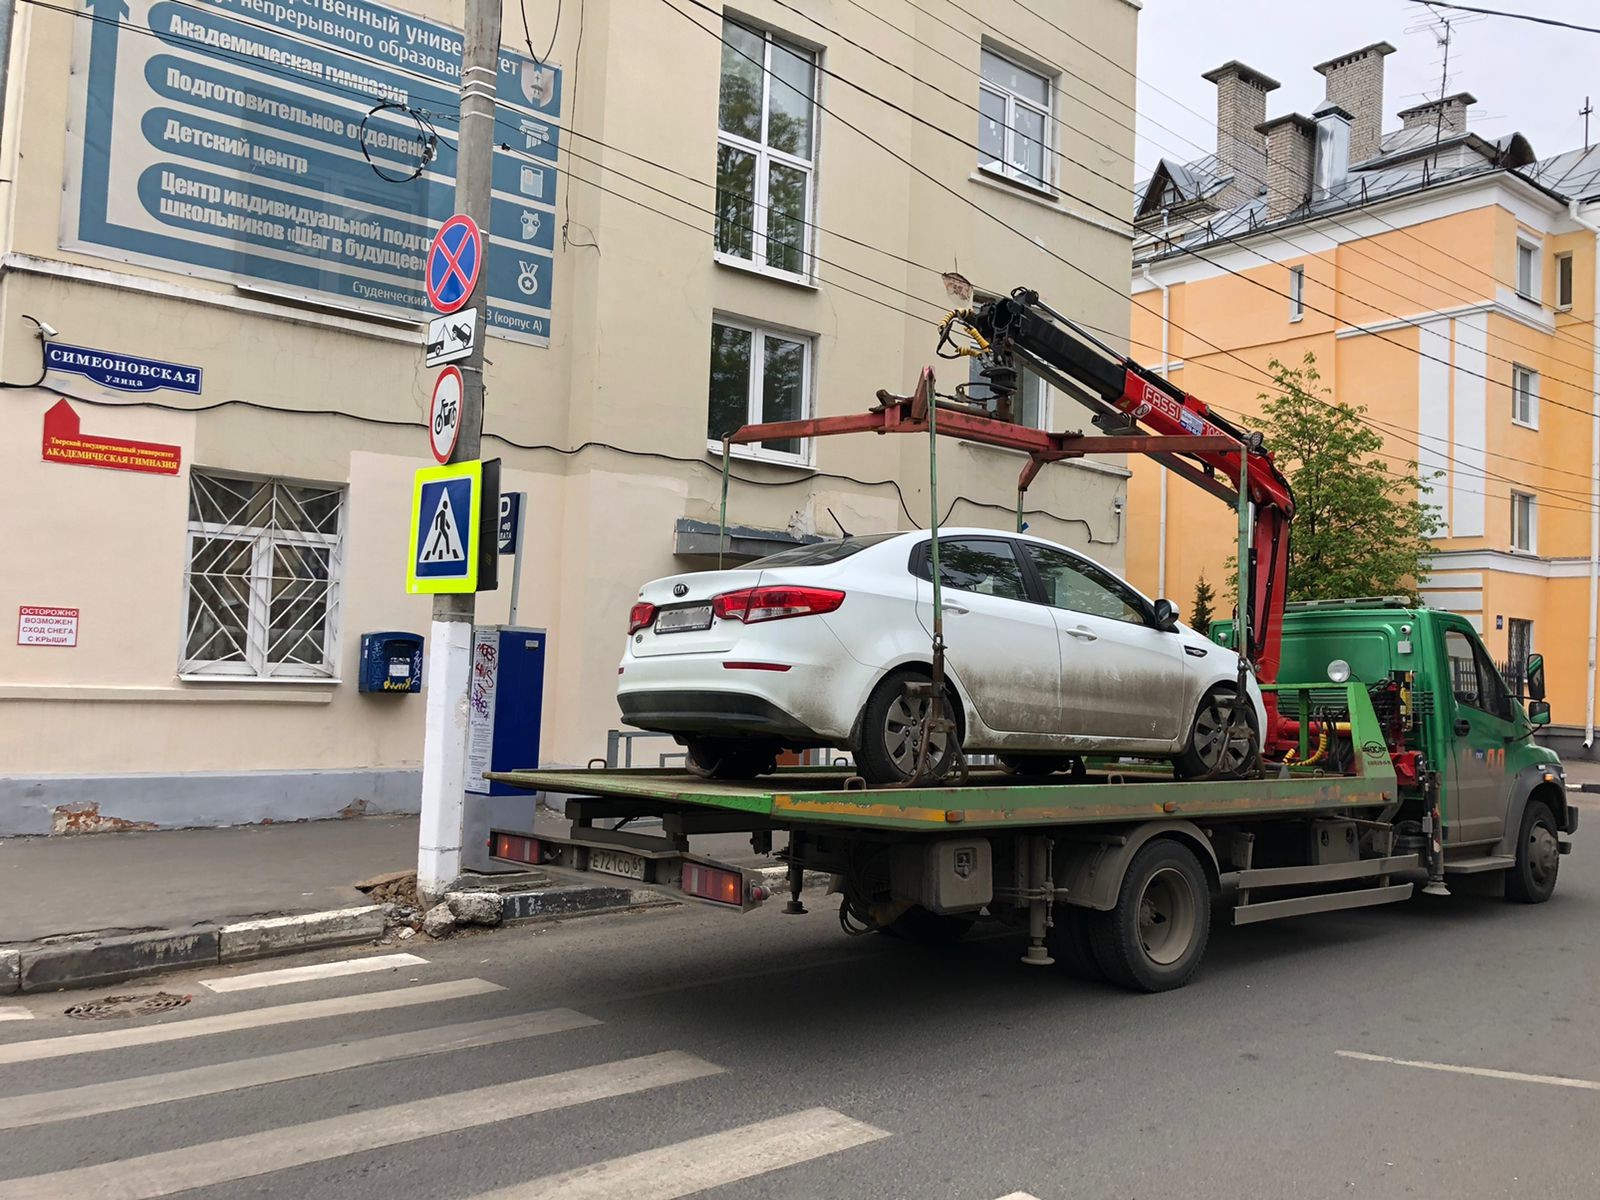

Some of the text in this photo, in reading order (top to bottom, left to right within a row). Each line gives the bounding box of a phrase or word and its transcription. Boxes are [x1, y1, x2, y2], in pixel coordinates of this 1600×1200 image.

[288, 0, 400, 36] твенный
[240, 0, 461, 77] непрерывного образован
[169, 14, 409, 105] Академическая гимназия
[166, 67, 437, 161] Подготовительное отделени
[163, 118, 308, 174] Детский центр
[161, 171, 220, 203] Центр
[223, 189, 382, 241] индивидуальной
[159, 197, 285, 241] школьников
[331, 237, 343, 254] в
[352, 281, 428, 307] Студенческий
[494, 311, 531, 332] (корпус
[50, 349, 197, 384] СИМЕОНОВСКАЯ
[104, 374, 144, 387] улица
[1145, 387, 1180, 419] FASSI
[46, 447, 178, 469] АКАДЕМИЧЕСКАЯ ГИМНАЗИЯ
[51, 437, 175, 458] Тверской государственный университет
[21, 607, 77, 617] ОСТОРОЖНО
[24, 617, 73, 625] ВОЗМОЖЕН
[22, 626, 45, 634] СХОД
